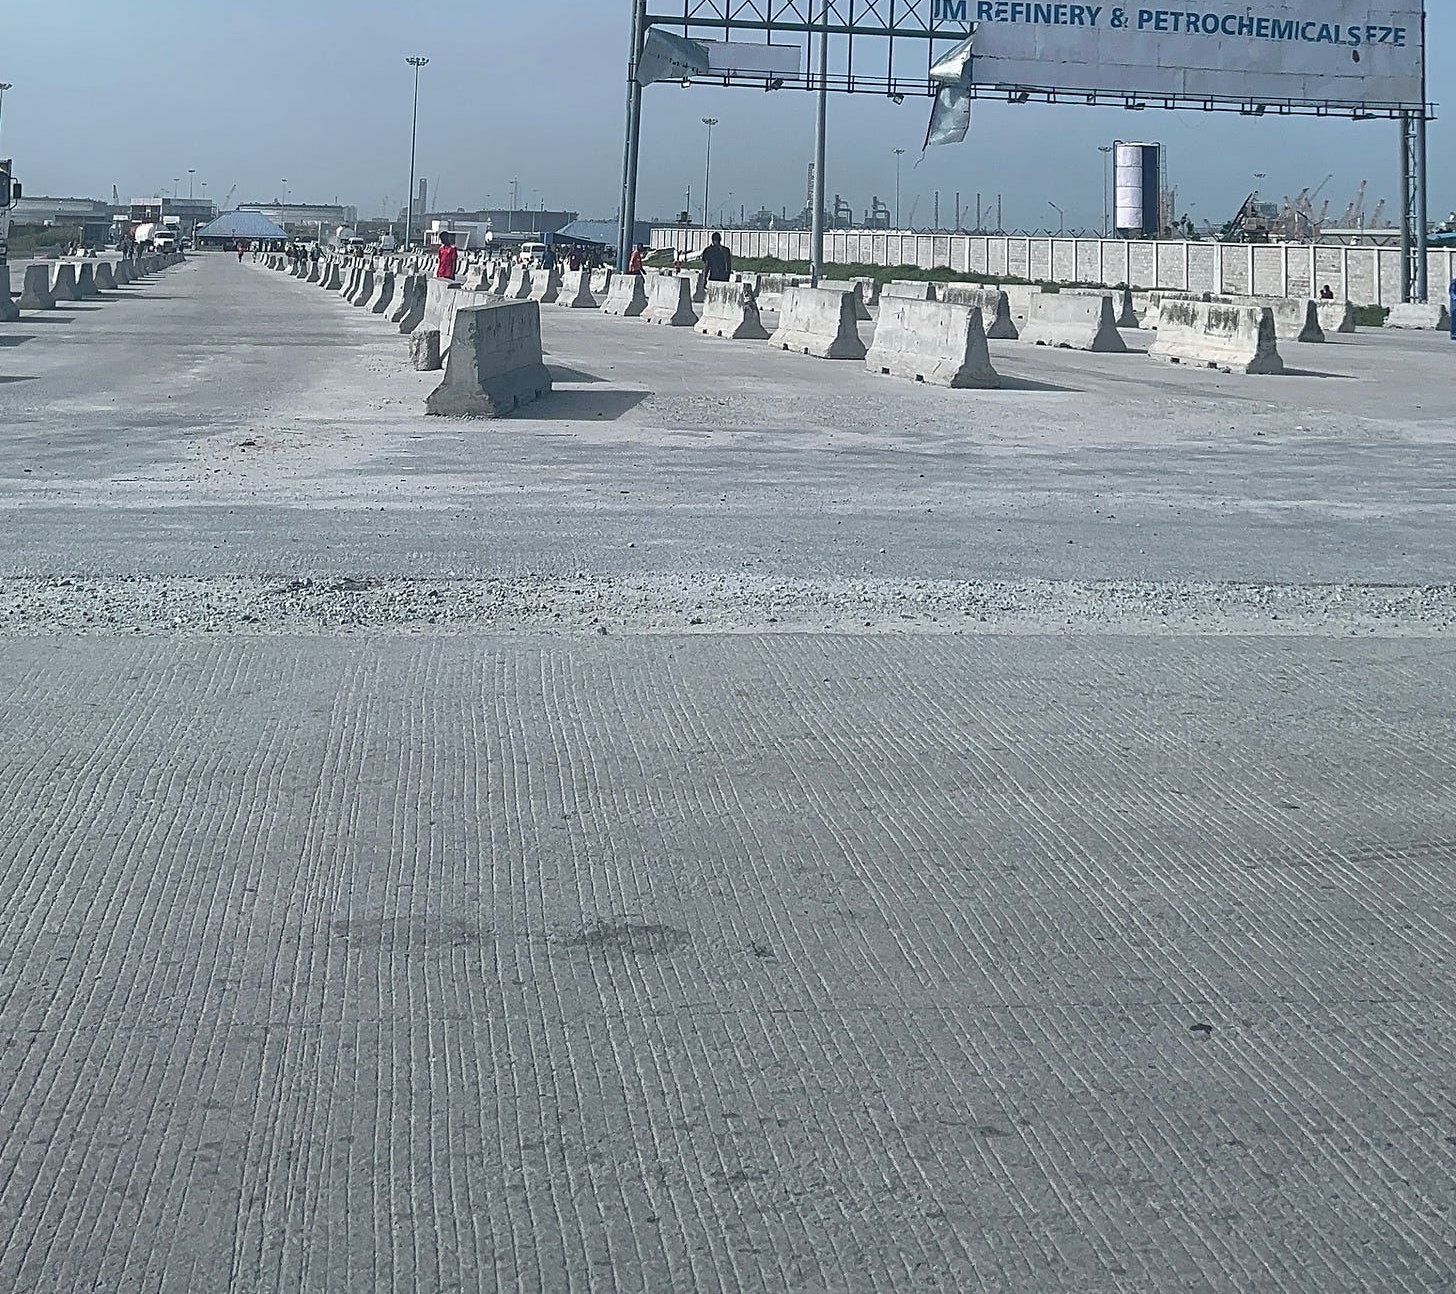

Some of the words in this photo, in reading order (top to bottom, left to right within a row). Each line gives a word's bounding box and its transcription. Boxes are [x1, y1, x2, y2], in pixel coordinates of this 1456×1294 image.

[976, 0, 1102, 27] REFINERY
[1110, 7, 1129, 29] &
[1137, 9, 1361, 47] PETROCHEMICALS
[1365, 25, 1406, 47] FZE
